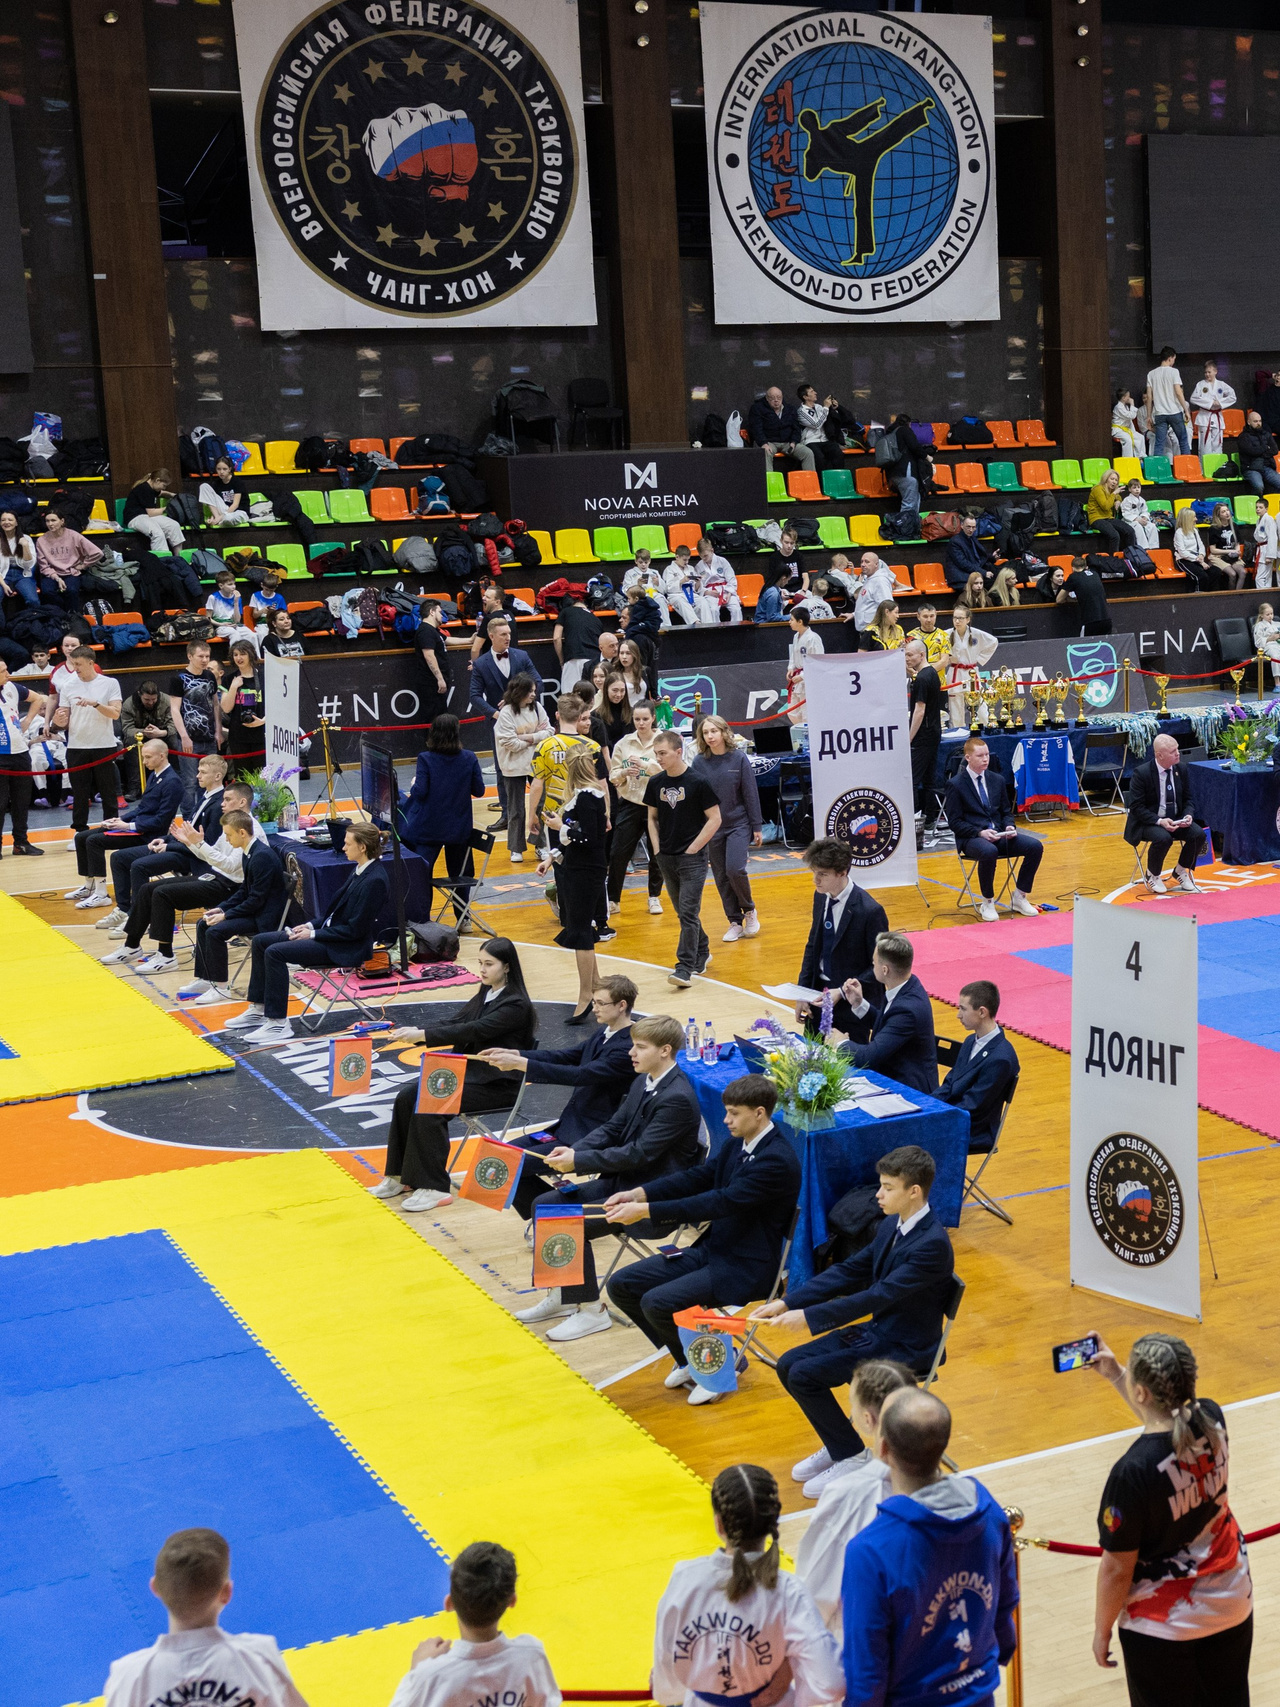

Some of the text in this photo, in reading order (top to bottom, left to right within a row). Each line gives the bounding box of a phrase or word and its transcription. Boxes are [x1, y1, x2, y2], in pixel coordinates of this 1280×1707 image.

[723, 17, 982, 150] INTERNATIONAL CH'ANG-HON
[272, 0, 564, 242] ВСЕРОССИЙСКАЯ ФЕДЕРАЦИЯ ТХЭКВОНДО
[735, 196, 978, 302] TAEKWON-DO FEDERATION
[365, 270, 496, 305] ЧАНГ-ХОН
[584, 494, 699, 511] NOVA ARENA
[599, 510, 687, 520] СПОРТИВНЫЙ КОМПЛЕКС
[283, 675, 288, 698] 5
[849, 671, 862, 695] 3
[272, 724, 299, 757] ДОЯНГ
[818, 725, 899, 761] ДОЯНГ
[842, 790, 885, 803] TAEKWON-DO
[883, 799, 900, 841] FEDERATION
[851, 853, 885, 866] HANG-HON
[1125, 940, 1142, 982] 4
[1085, 1025, 1185, 1086] ДОЯНГ
[1087, 1137, 1181, 1246] ВСЕРОССИЙСКАЯ ФЕДЕРАЦИЯ ТХЭКВОНДО
[1113, 1242, 1156, 1264] ЧАНГ-ХОН
[673, 1612, 773, 1666] TAEKWON-DO
